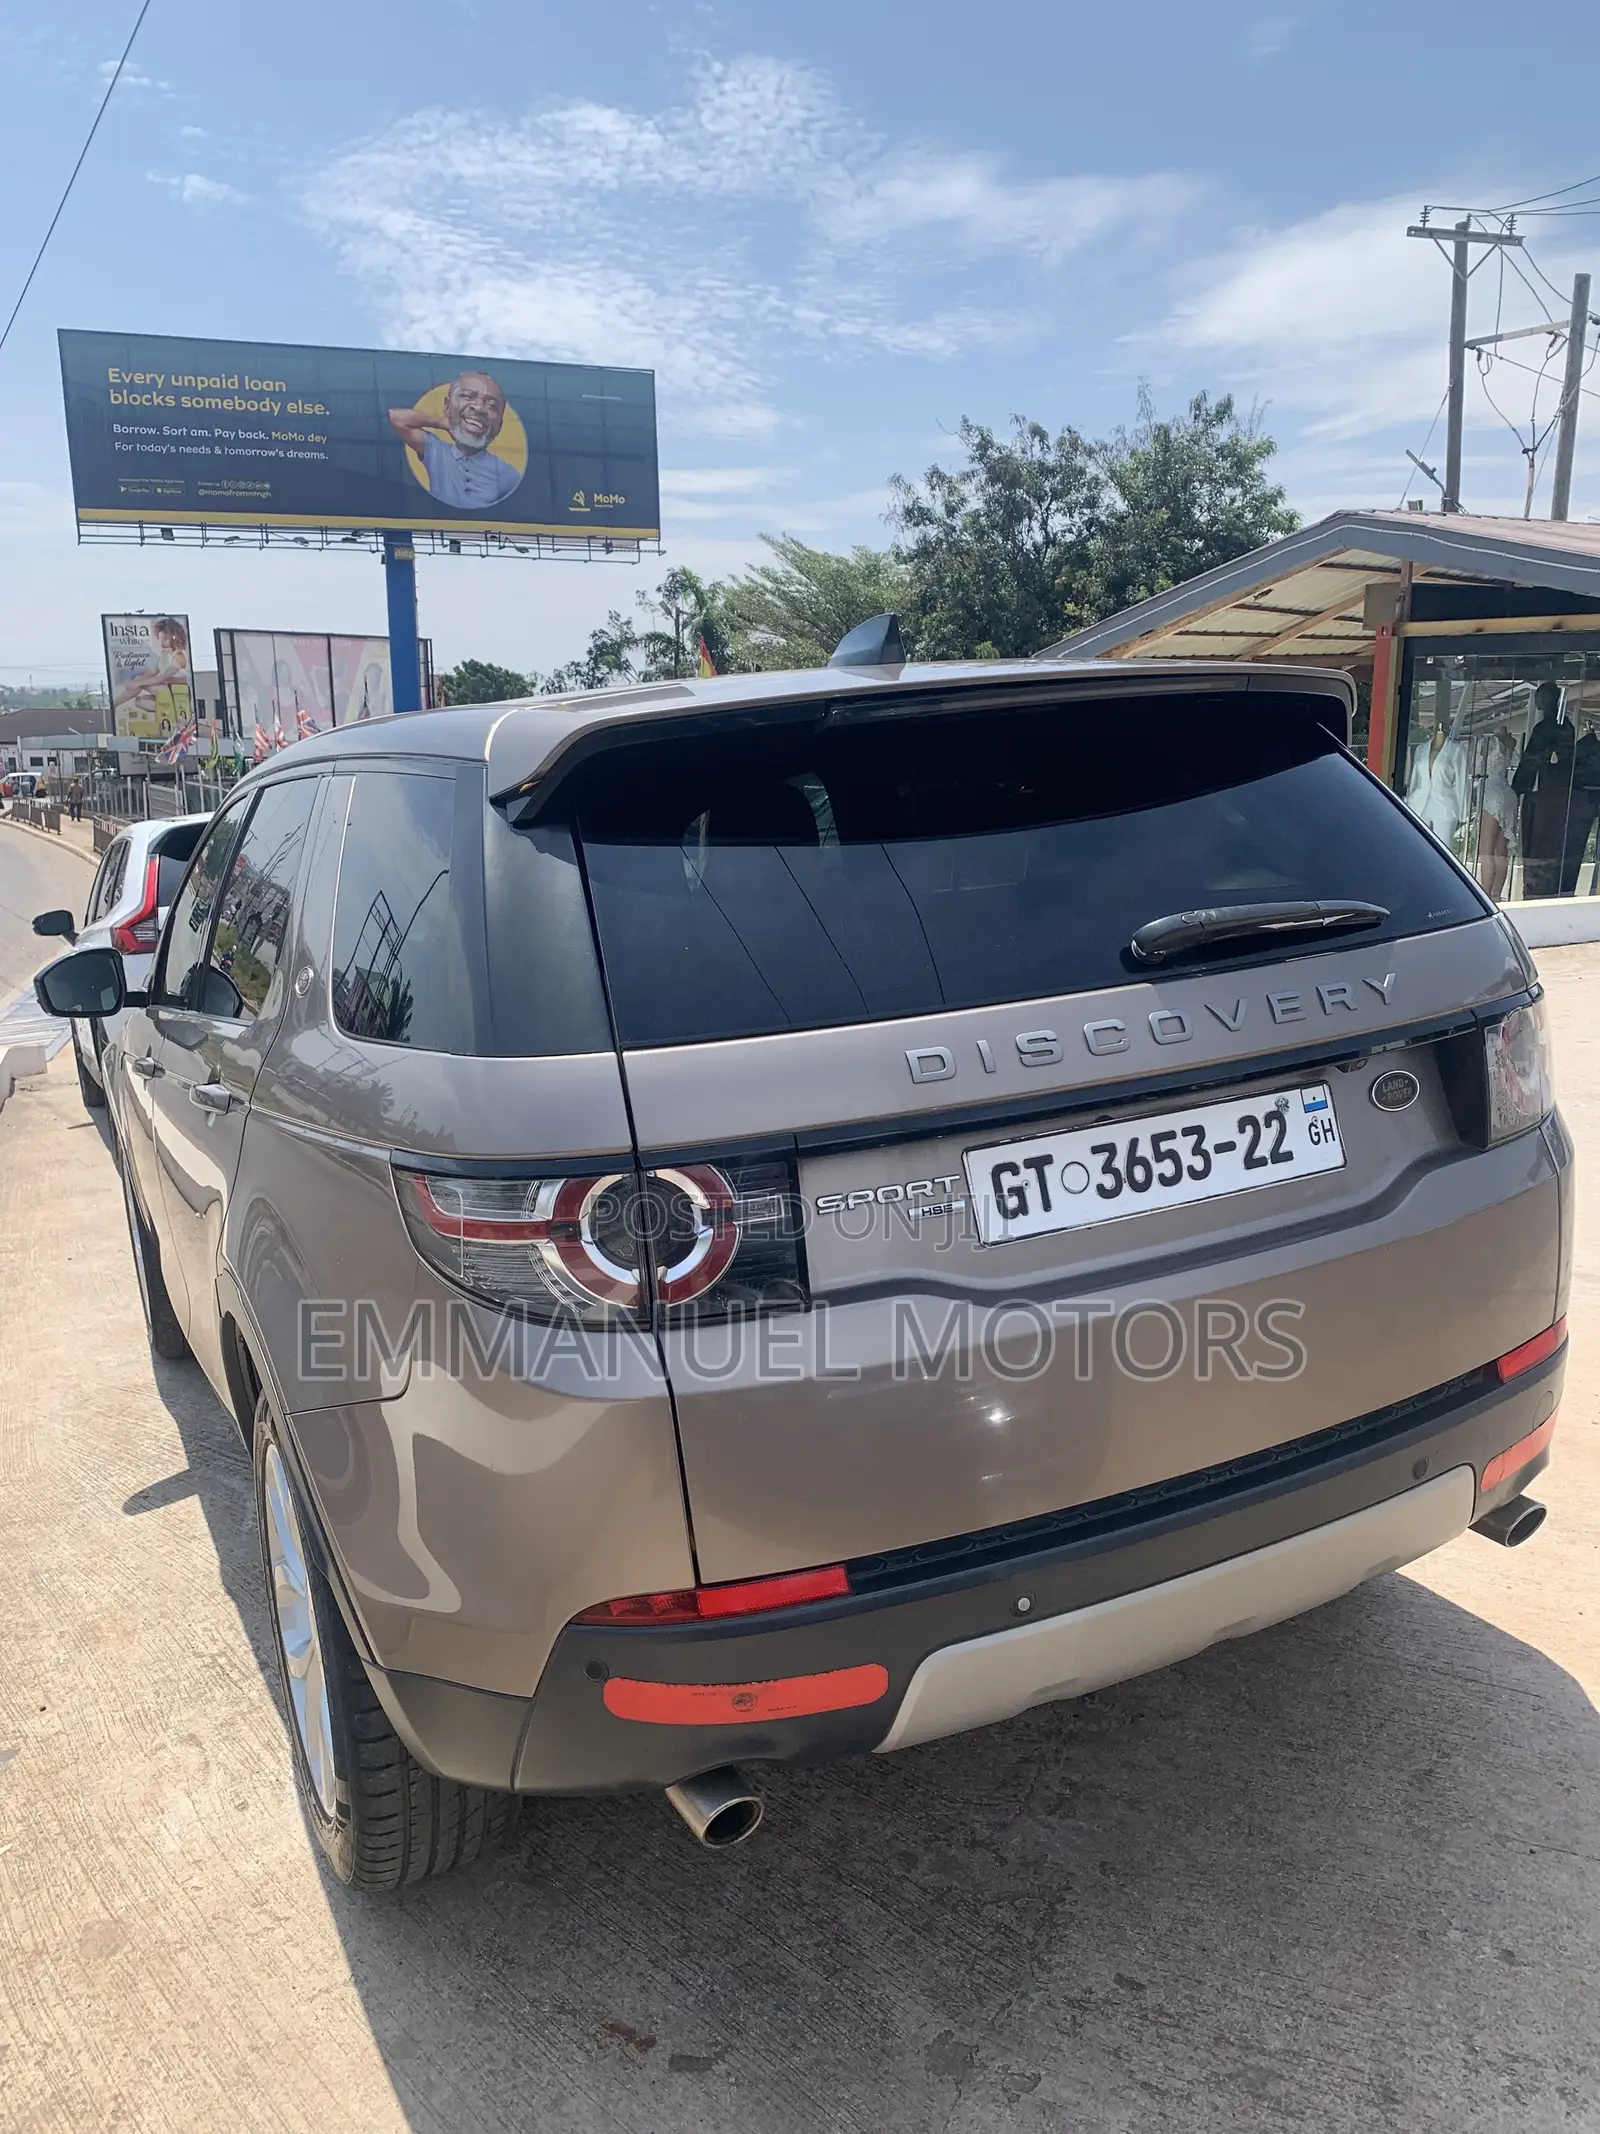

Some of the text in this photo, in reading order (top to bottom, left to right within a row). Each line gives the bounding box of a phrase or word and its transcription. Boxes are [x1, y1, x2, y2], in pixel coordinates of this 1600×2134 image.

[107, 367, 287, 392] Every unpaid loan
[109, 388, 330, 416] blocks somebody else.
[113, 423, 327, 444] Borrow. Sort am. Pay back. MoMo dey
[114, 441, 329, 460] For today's needs & tomorrow's dreams.
[593, 493, 626, 504] MoMo
[110, 621, 150, 637] Insta
[904, 972, 1398, 1085] DISCOVERY
[1307, 1117, 1335, 1147] GH
[991, 1109, 1295, 1220] GT 3653-22
[816, 1173, 961, 1216] SPORT
[921, 1203, 954, 1218] HSE
